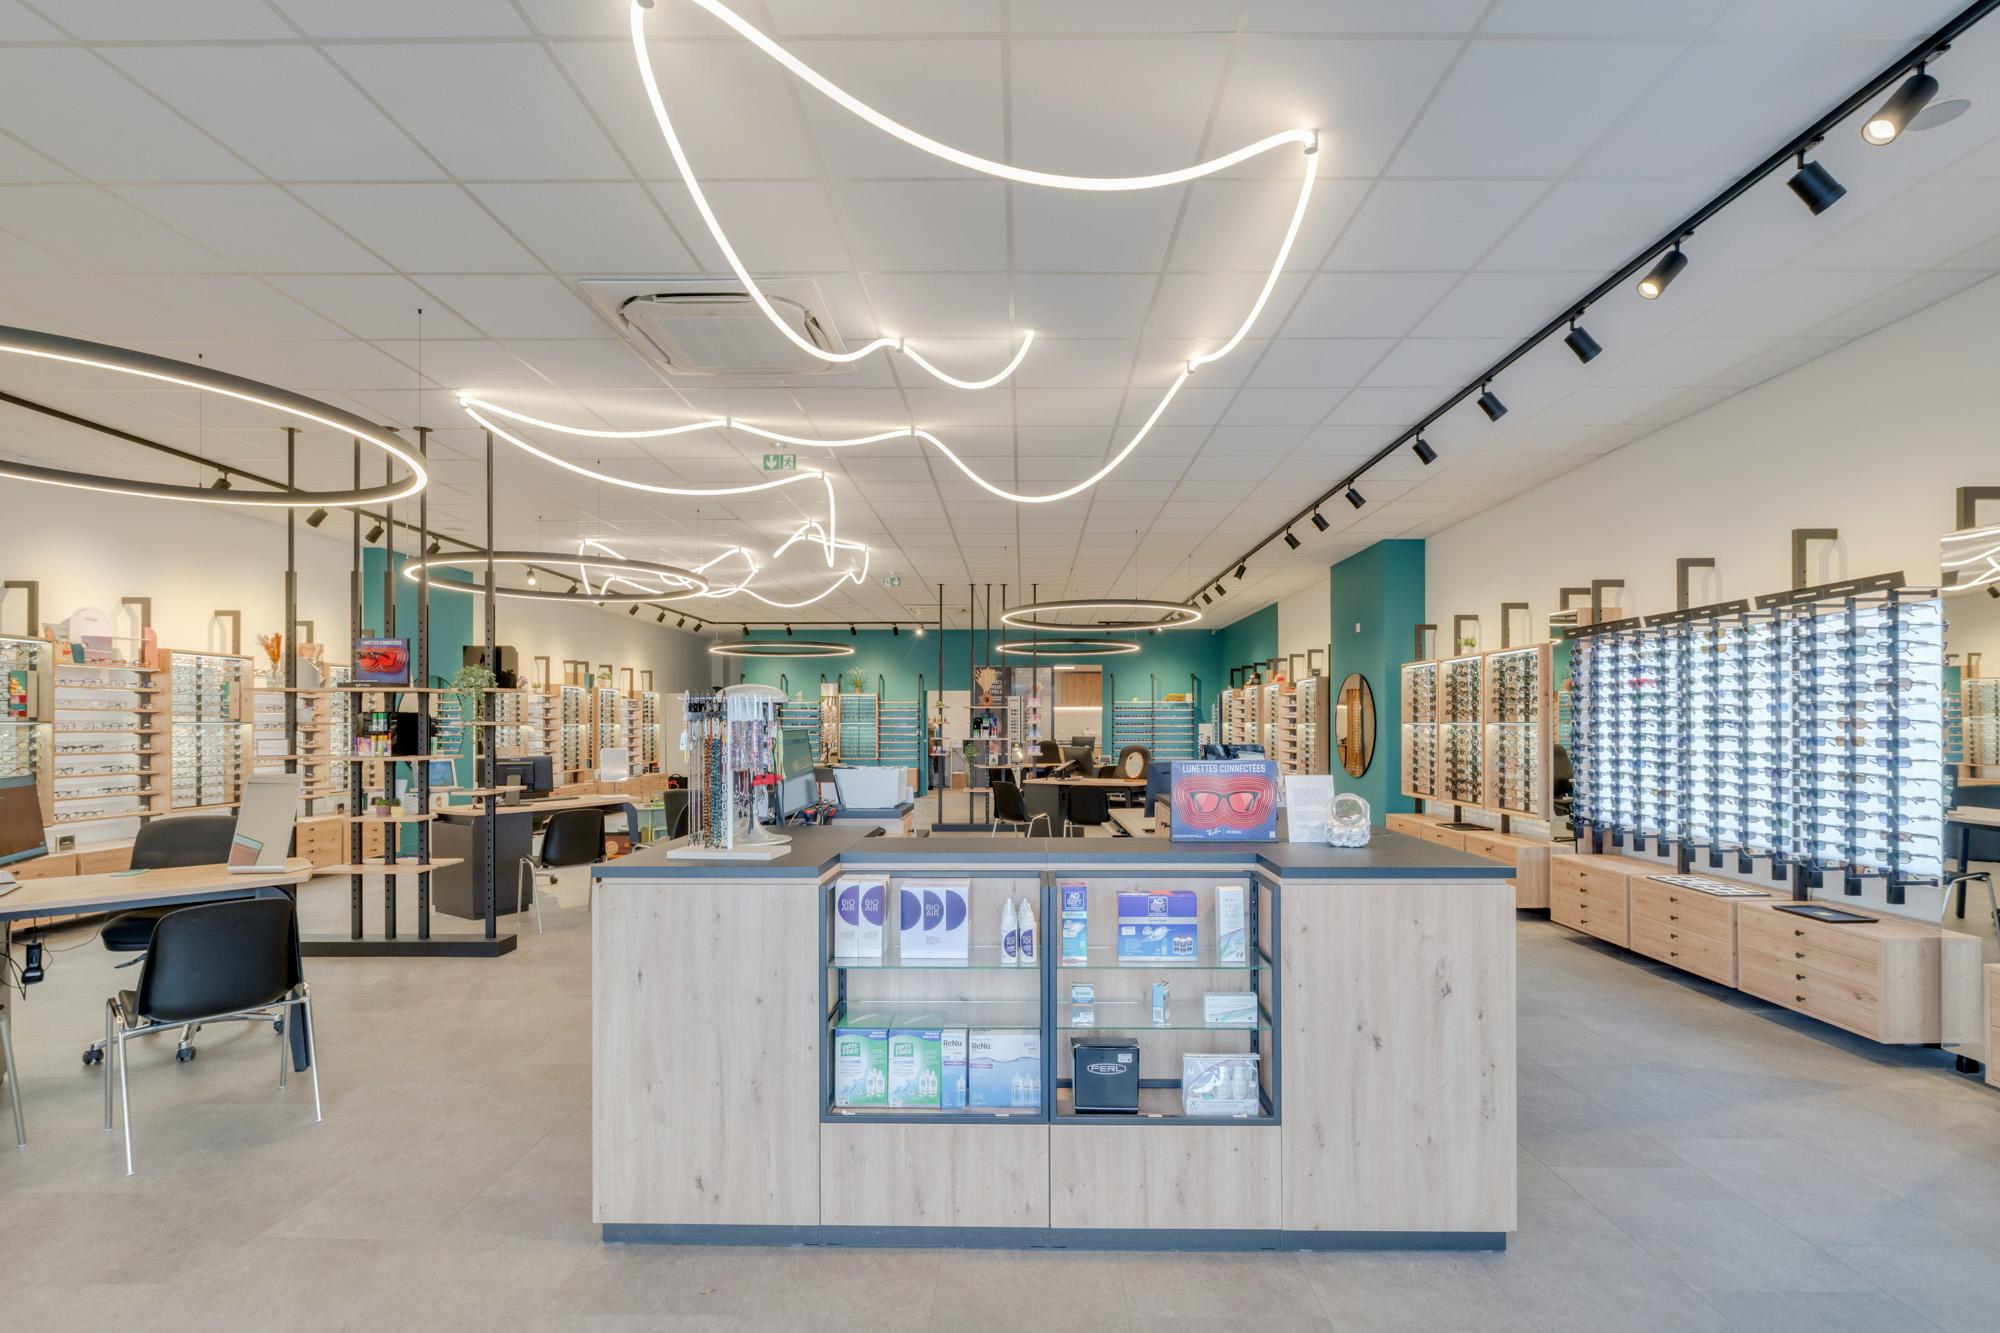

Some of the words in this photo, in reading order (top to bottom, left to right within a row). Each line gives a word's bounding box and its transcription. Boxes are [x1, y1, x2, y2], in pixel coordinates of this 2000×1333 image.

[1182, 764, 1217, 773] LUNETTES
[1219, 763, 1266, 773] CONNECTÉES
[841, 898, 856, 906] BIO
[864, 898, 879, 906] BIO
[971, 1042, 991, 1050] ReNu
[1091, 1065, 1122, 1073] PERL
